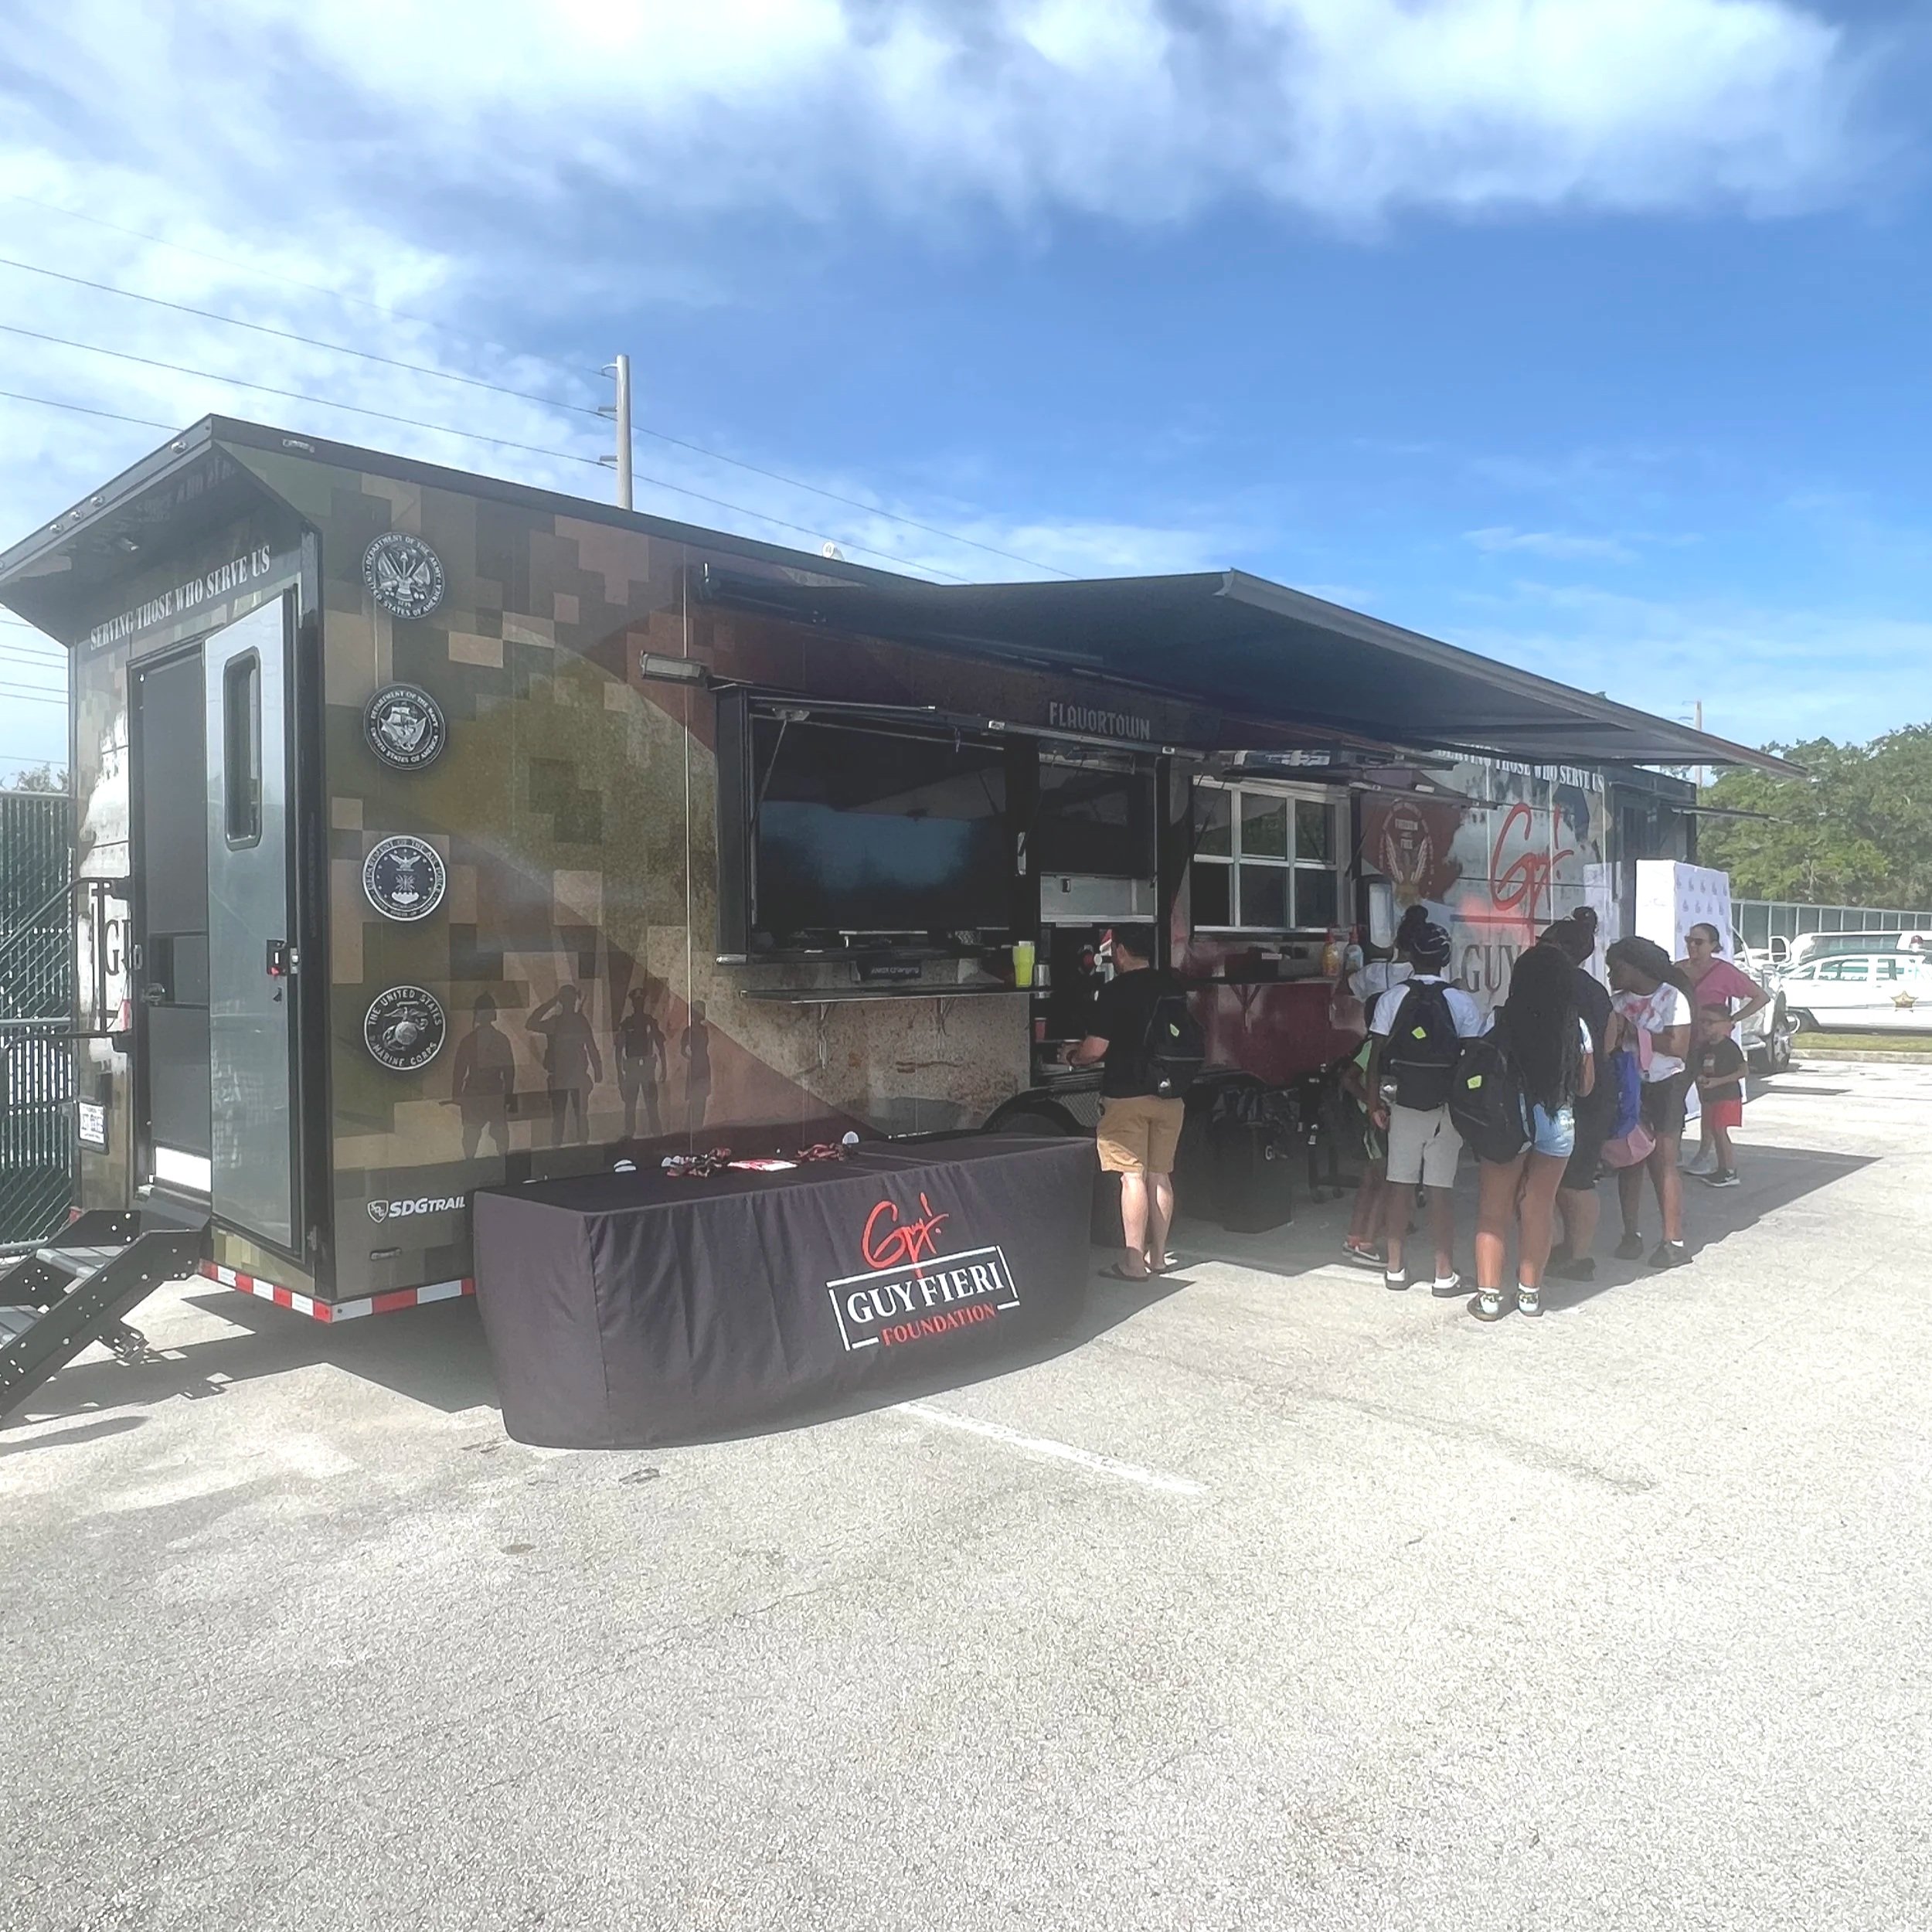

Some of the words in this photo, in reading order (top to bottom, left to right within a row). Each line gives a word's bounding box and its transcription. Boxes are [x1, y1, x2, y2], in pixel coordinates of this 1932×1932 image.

[90, 611, 134, 651] SERVING
[135, 590, 172, 631] THOSE
[175, 578, 204, 612] WHO
[206, 556, 248, 599] SERVE
[251, 544, 270, 577] US
[1534, 764, 1558, 782] WHO
[1560, 764, 1590, 791] SERVE
[1592, 773, 1605, 793] US
[368, 1007, 382, 1026] THE
[379, 989, 416, 1006] UNITED
[419, 994, 443, 1026] STATES
[372, 1044, 405, 1067] MARINE
[410, 1042, 437, 1065] CORPS
[846, 1280, 916, 1324] GUY
[917, 1261, 1005, 1308] FIERI
[881, 1302, 997, 1346] FOUNDATION
